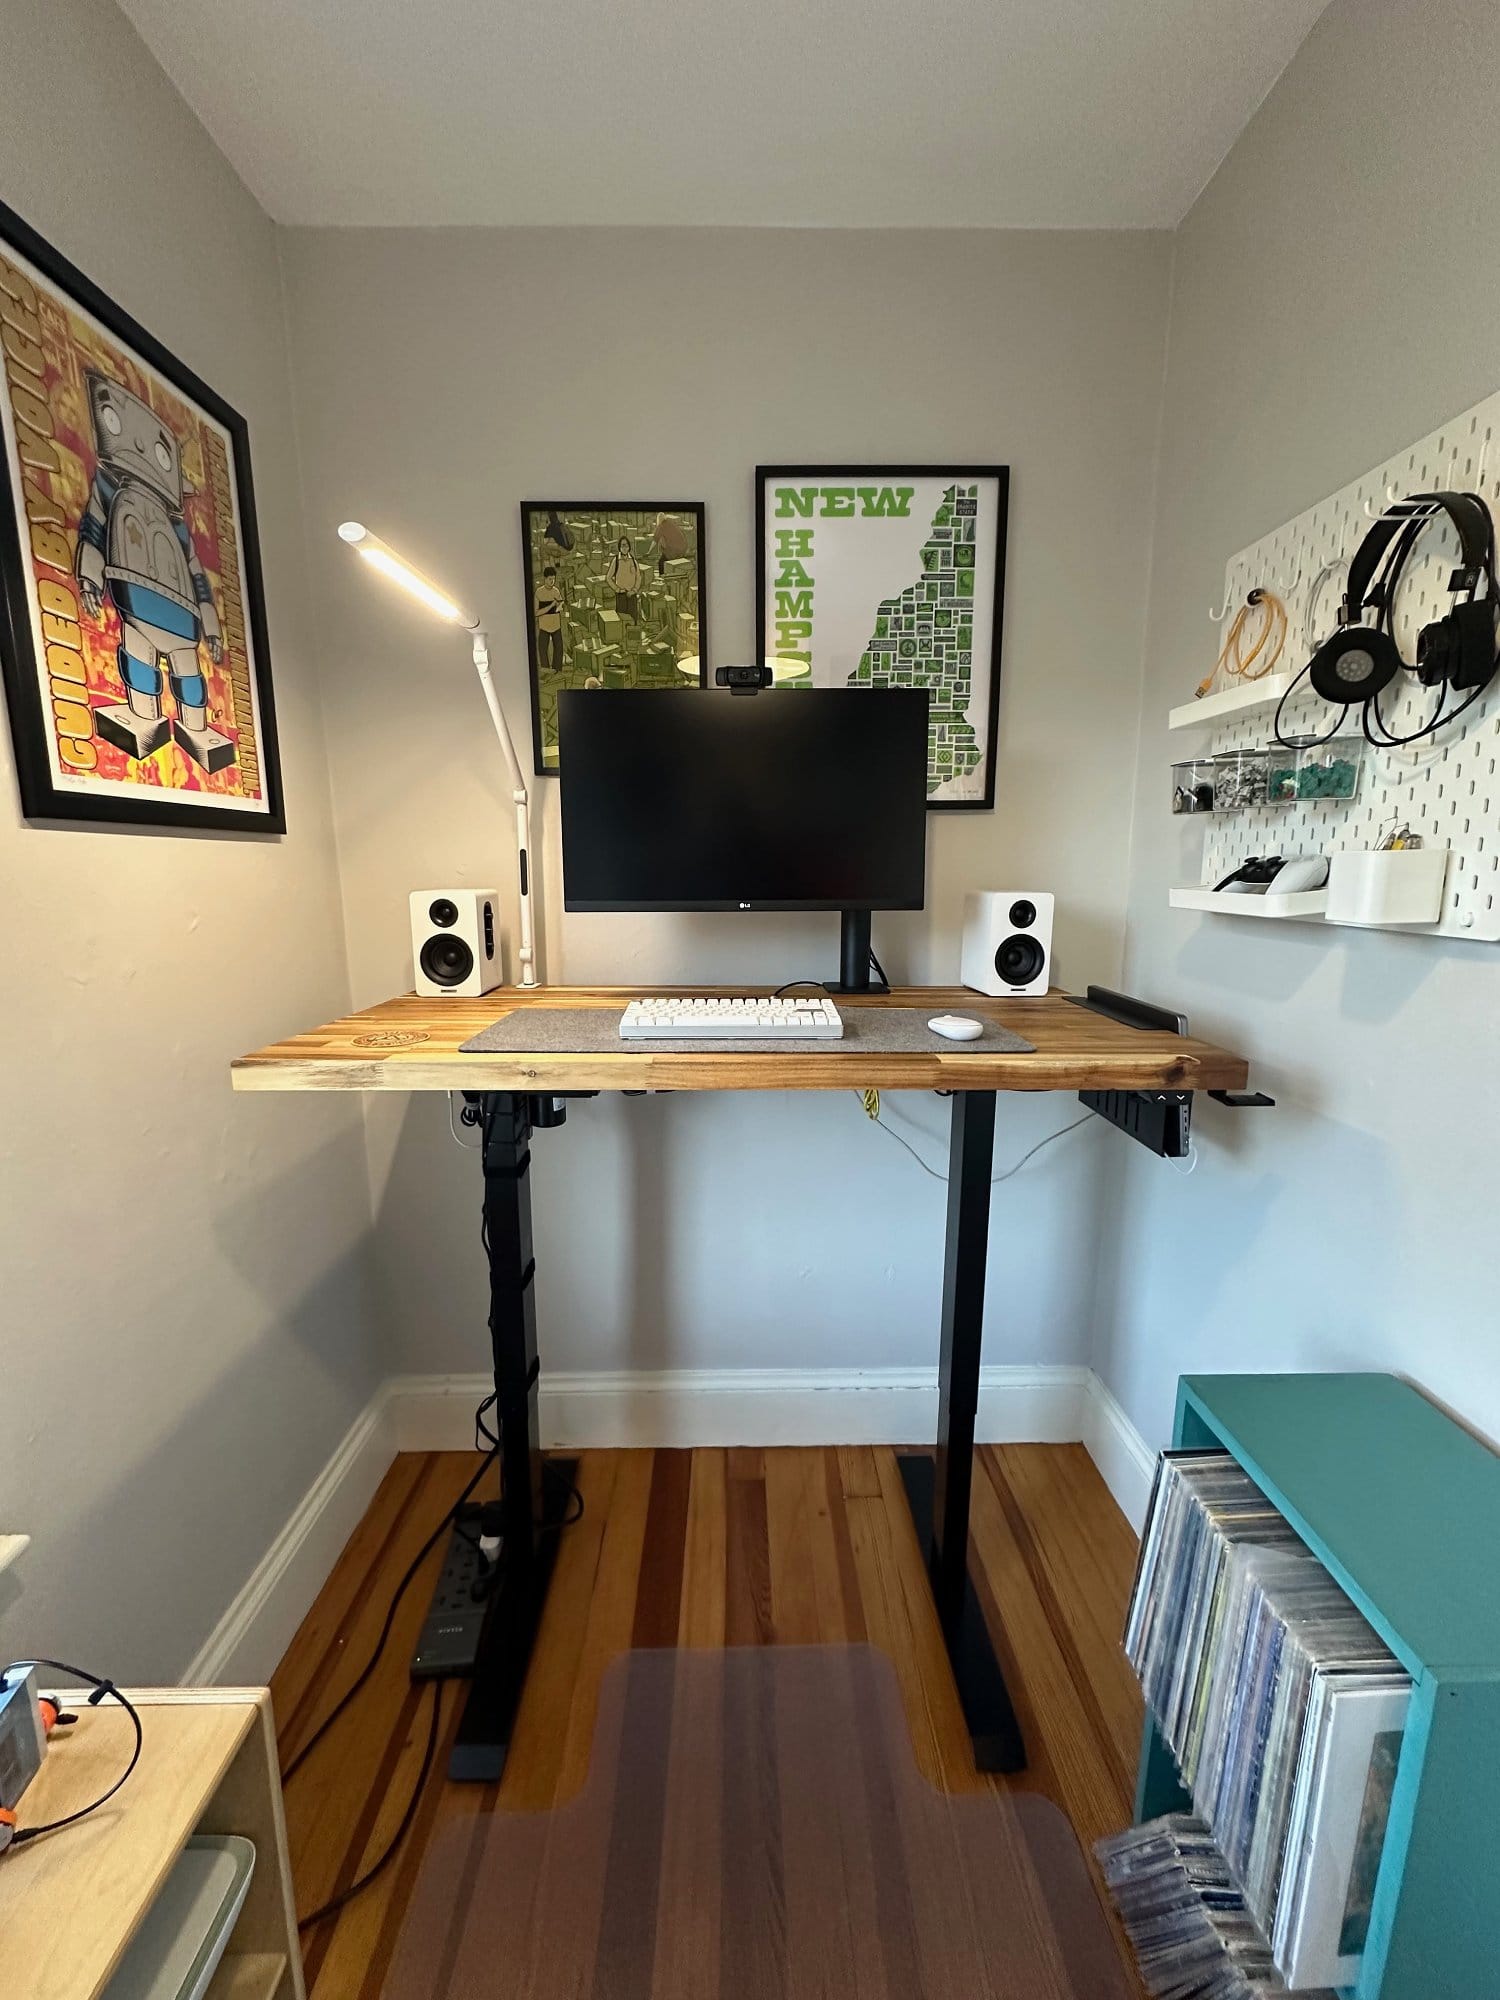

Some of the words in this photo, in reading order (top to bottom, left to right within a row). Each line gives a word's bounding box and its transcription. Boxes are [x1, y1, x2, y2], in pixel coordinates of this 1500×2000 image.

[0, 256, 61, 473] VOICES
[23, 475, 74, 576] BY
[775, 487, 914, 518] NEW
[223, 587, 247, 652] ANNEX
[774, 529, 814, 688] HAMP
[37, 579, 97, 770] GUIDED
[229, 649, 259, 771] INDIANAPOLIS
